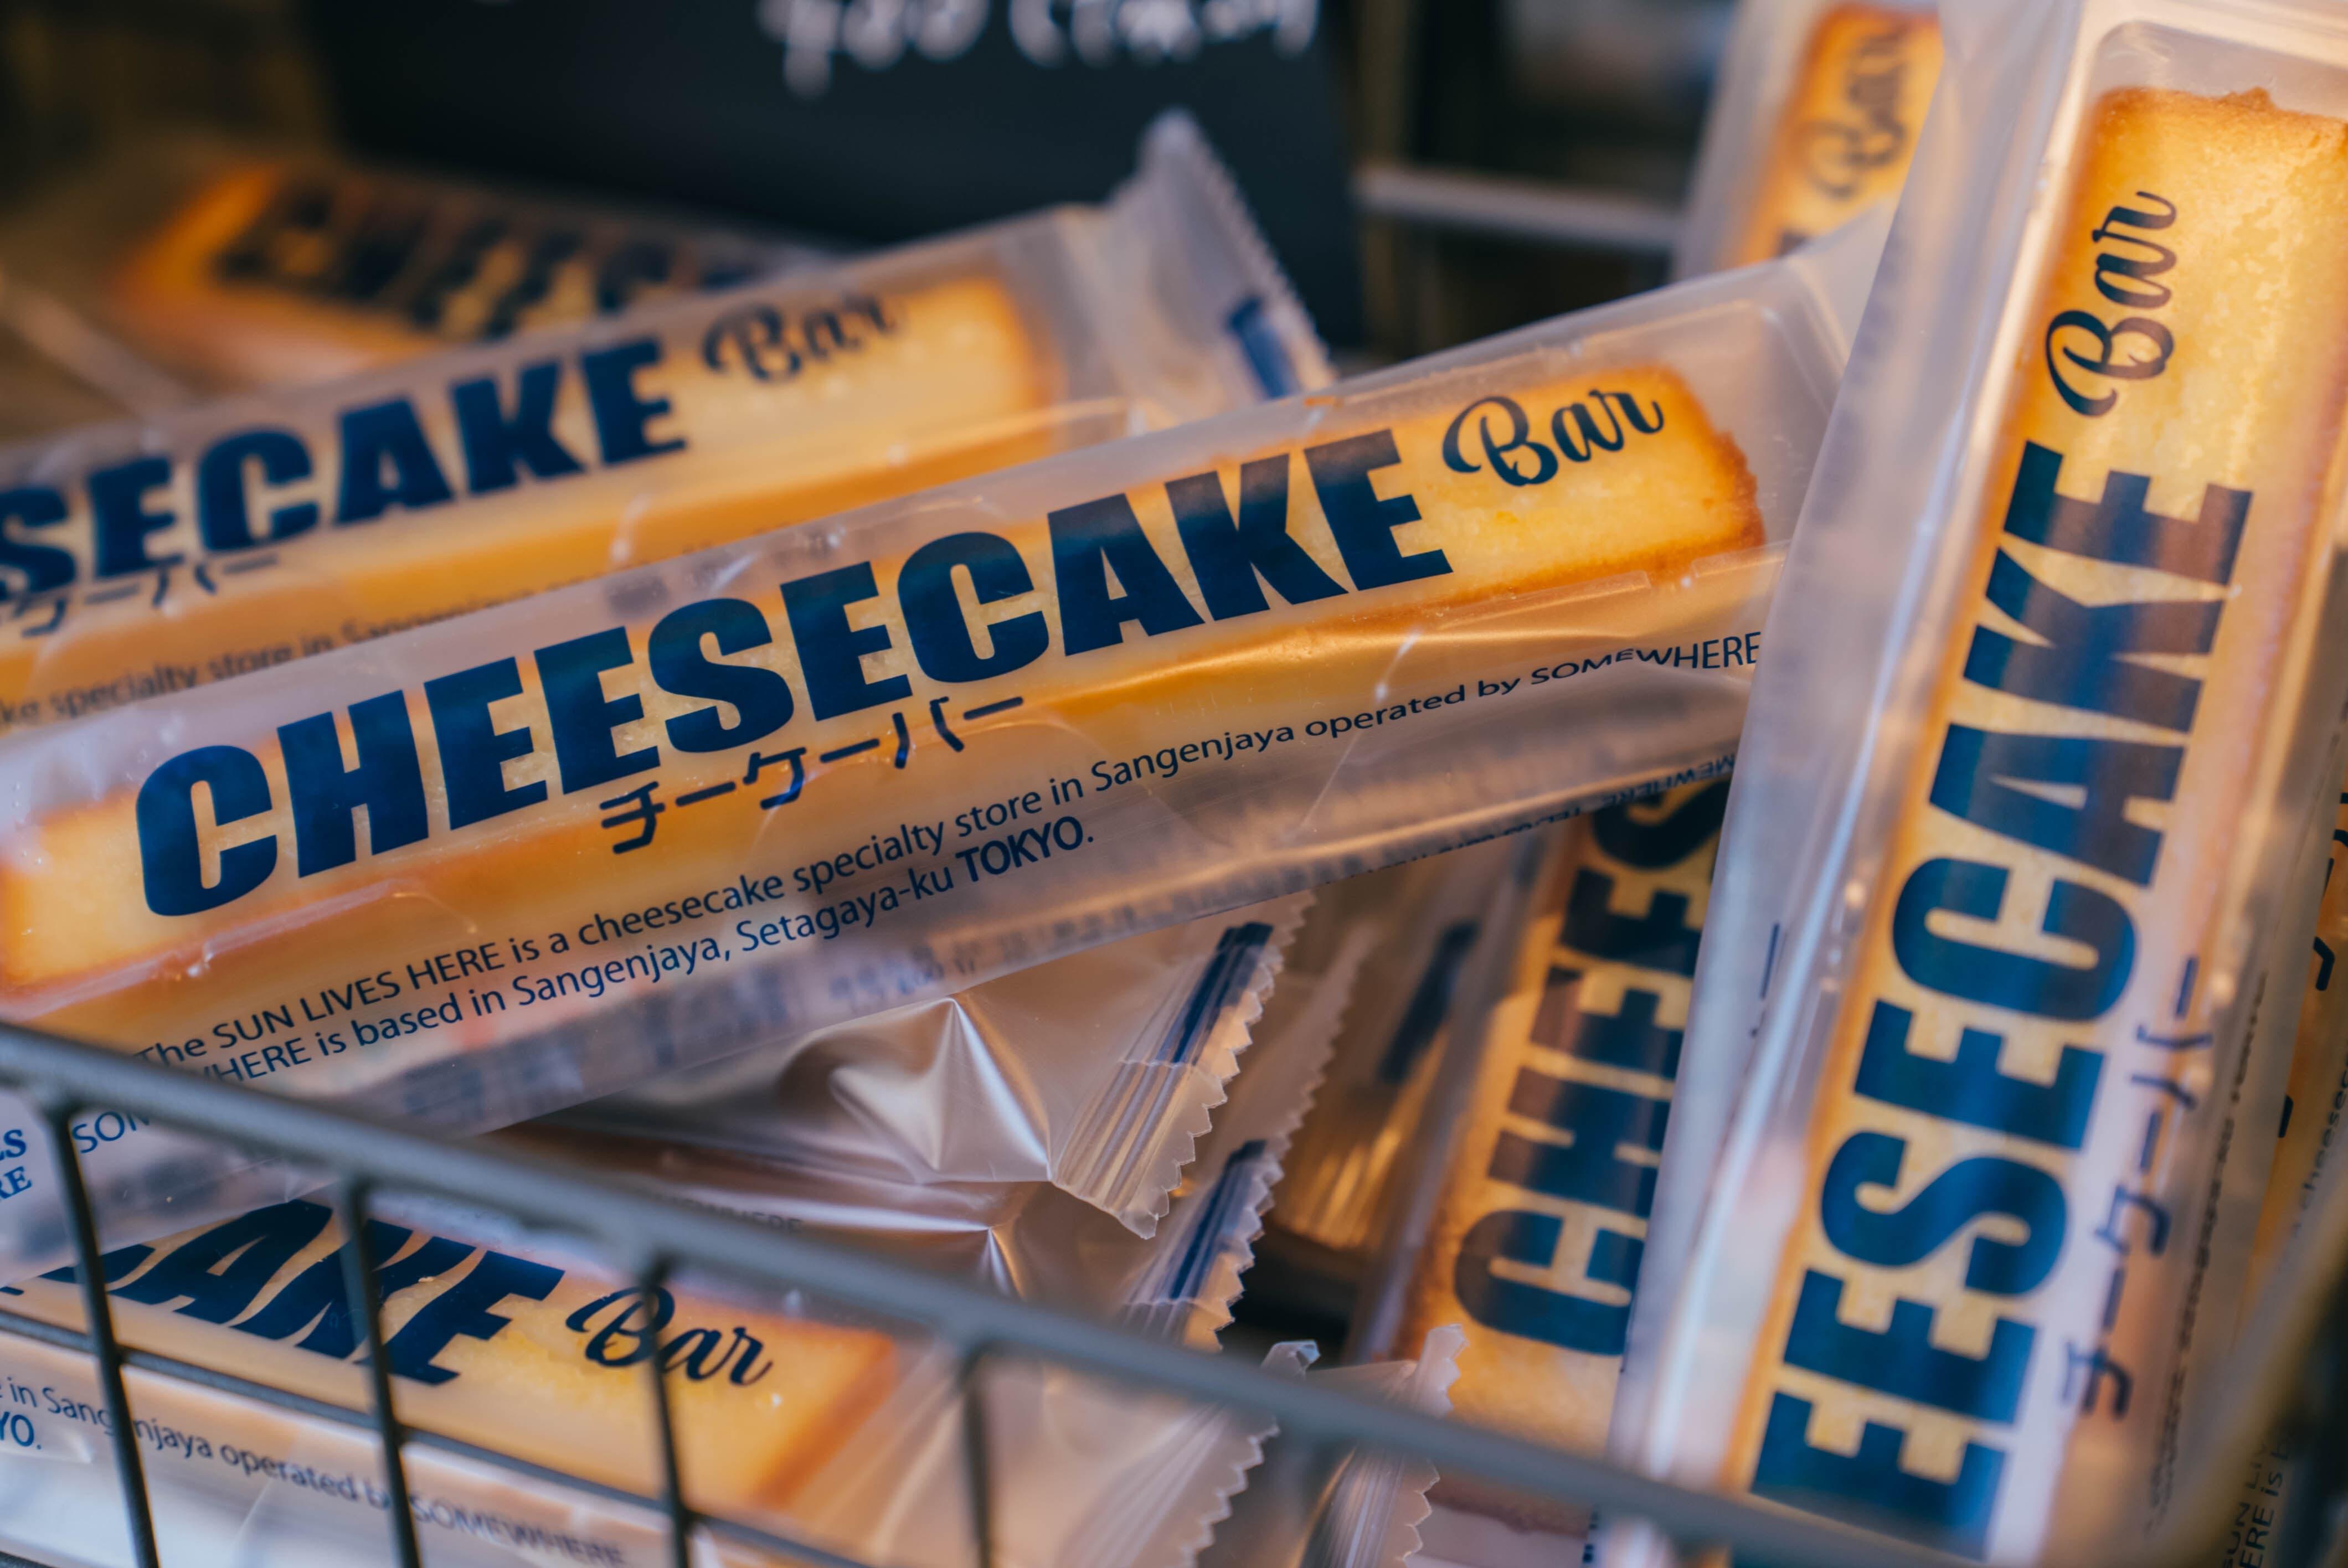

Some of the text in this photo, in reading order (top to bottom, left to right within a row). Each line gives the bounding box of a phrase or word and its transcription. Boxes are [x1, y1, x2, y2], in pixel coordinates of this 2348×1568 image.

[702, 289, 908, 383] Bar
[2045, 190, 2177, 417] Bar
[135, 389, 1664, 916] CHEESECAKE Bar
[213, 1004, 294, 1049] SUN
[300, 971, 400, 1021] LIVES
[406, 943, 504, 991] HERE
[508, 937, 540, 964] is
[549, 932, 569, 954] a
[578, 875, 783, 943] cheesecake
[793, 821, 945, 899] specialty
[955, 788, 1041, 837] store
[1050, 774, 1084, 806] in
[1091, 724, 1294, 792] Sangenjaya
[1305, 685, 1466, 738] operated
[1477, 678, 1521, 698] by
[1531, 632, 1761, 685] SOMEWHERE
[317, 1030, 347, 1058] is
[354, 989, 462, 1047] based
[471, 984, 506, 1018] in
[512, 937, 731, 1007] Sangenjaya,
[735, 864, 954, 952] Setagaya-ku
[956, 815, 1094, 883] TOKYO.
[7, 1376, 37, 1407] in
[219, 1444, 357, 1502] operated
[565, 1285, 773, 1386] Bar
